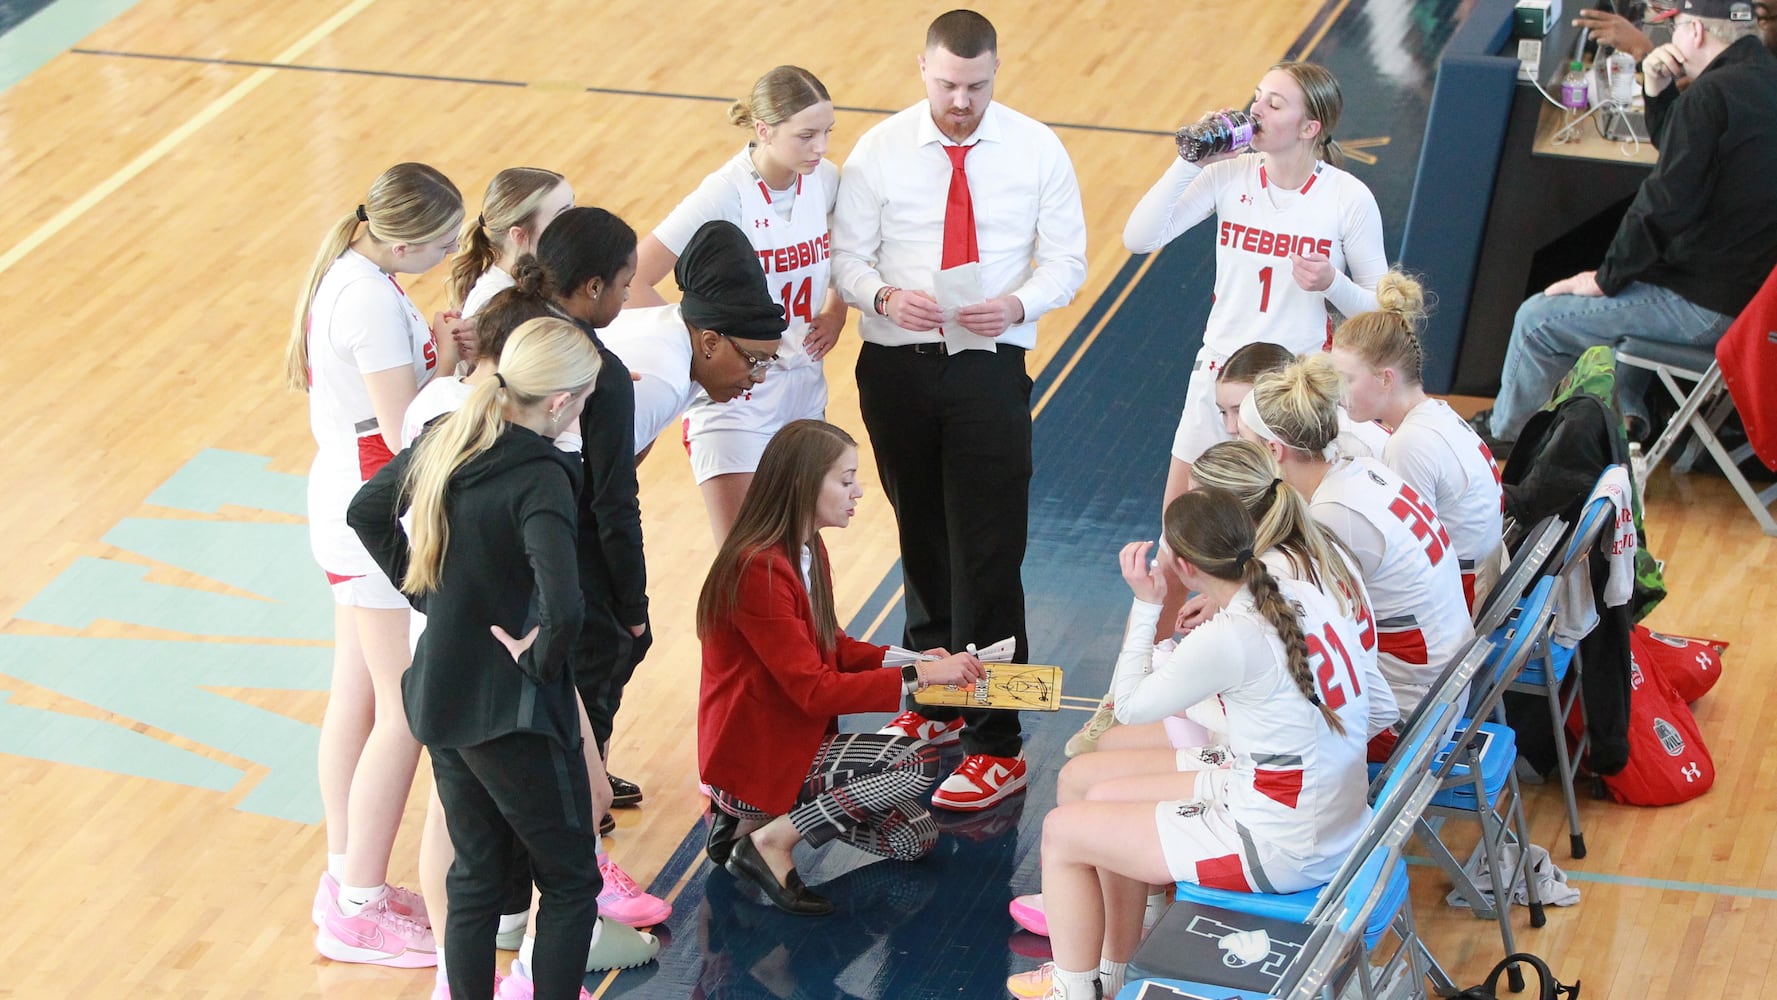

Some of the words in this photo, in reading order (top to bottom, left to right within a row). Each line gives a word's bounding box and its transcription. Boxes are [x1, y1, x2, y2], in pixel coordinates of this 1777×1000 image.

[754, 232, 831, 274] TEBBINS
[1219, 221, 1332, 258] STEBBINS
[781, 276, 812, 326] 14
[1258, 266, 1273, 313] 1
[1304, 621, 1361, 711] 21
